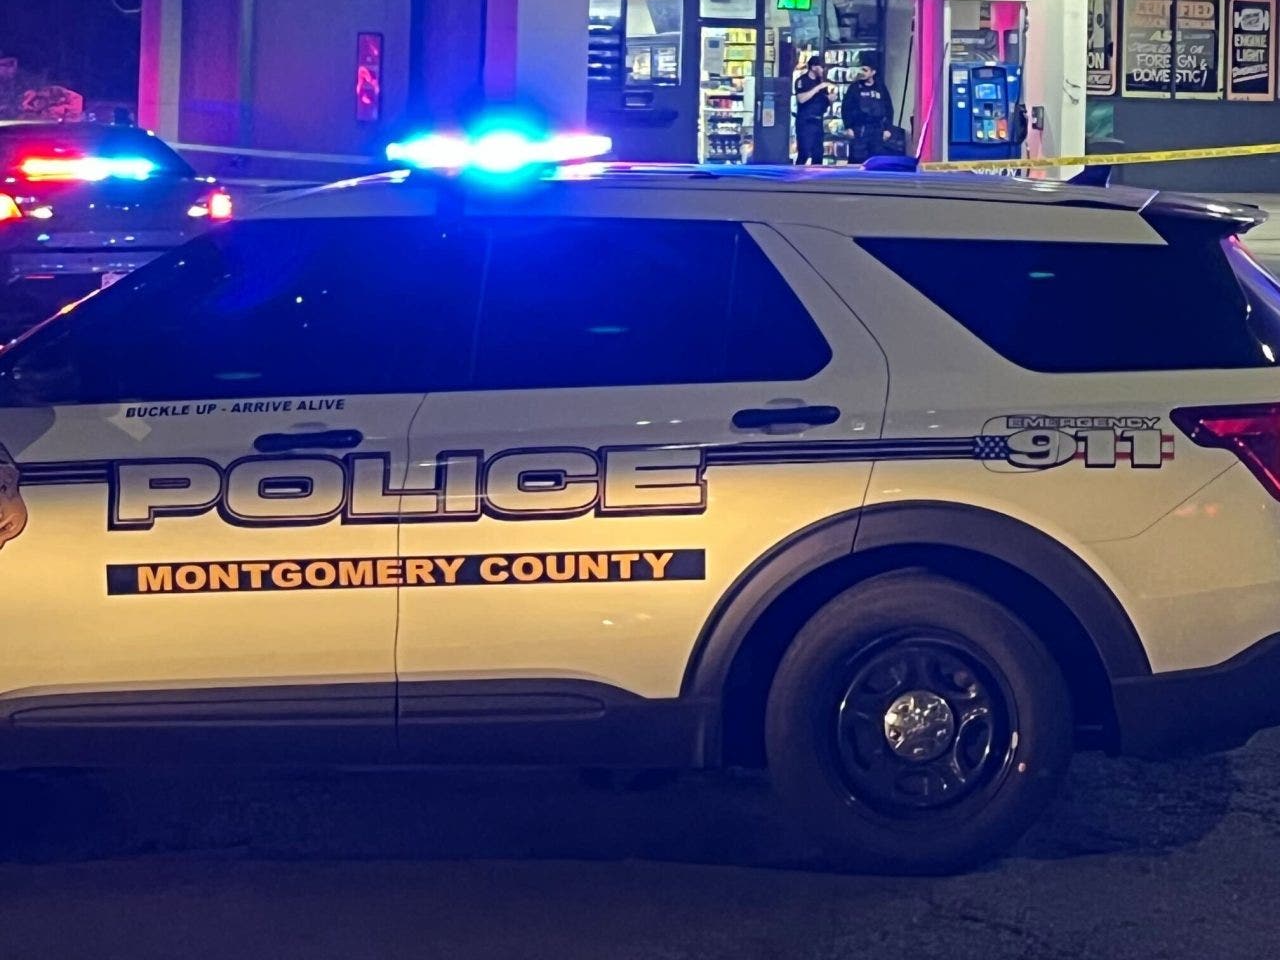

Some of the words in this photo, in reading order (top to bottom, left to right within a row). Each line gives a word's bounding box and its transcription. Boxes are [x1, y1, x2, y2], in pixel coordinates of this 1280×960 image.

[1137, 53, 1197, 69] FOREGN
[125, 404, 190, 418] BUCKLE
[196, 403, 217, 416] UP
[230, 400, 292, 413] ARRIVE
[296, 398, 346, 411] ALIVE
[1007, 416, 1160, 429] EMERGENCY
[1007, 428, 1162, 469] 911
[107, 446, 707, 531] POLICE
[137, 557, 466, 593] MONTGOMERY
[479, 551, 675, 583] COUNTY
